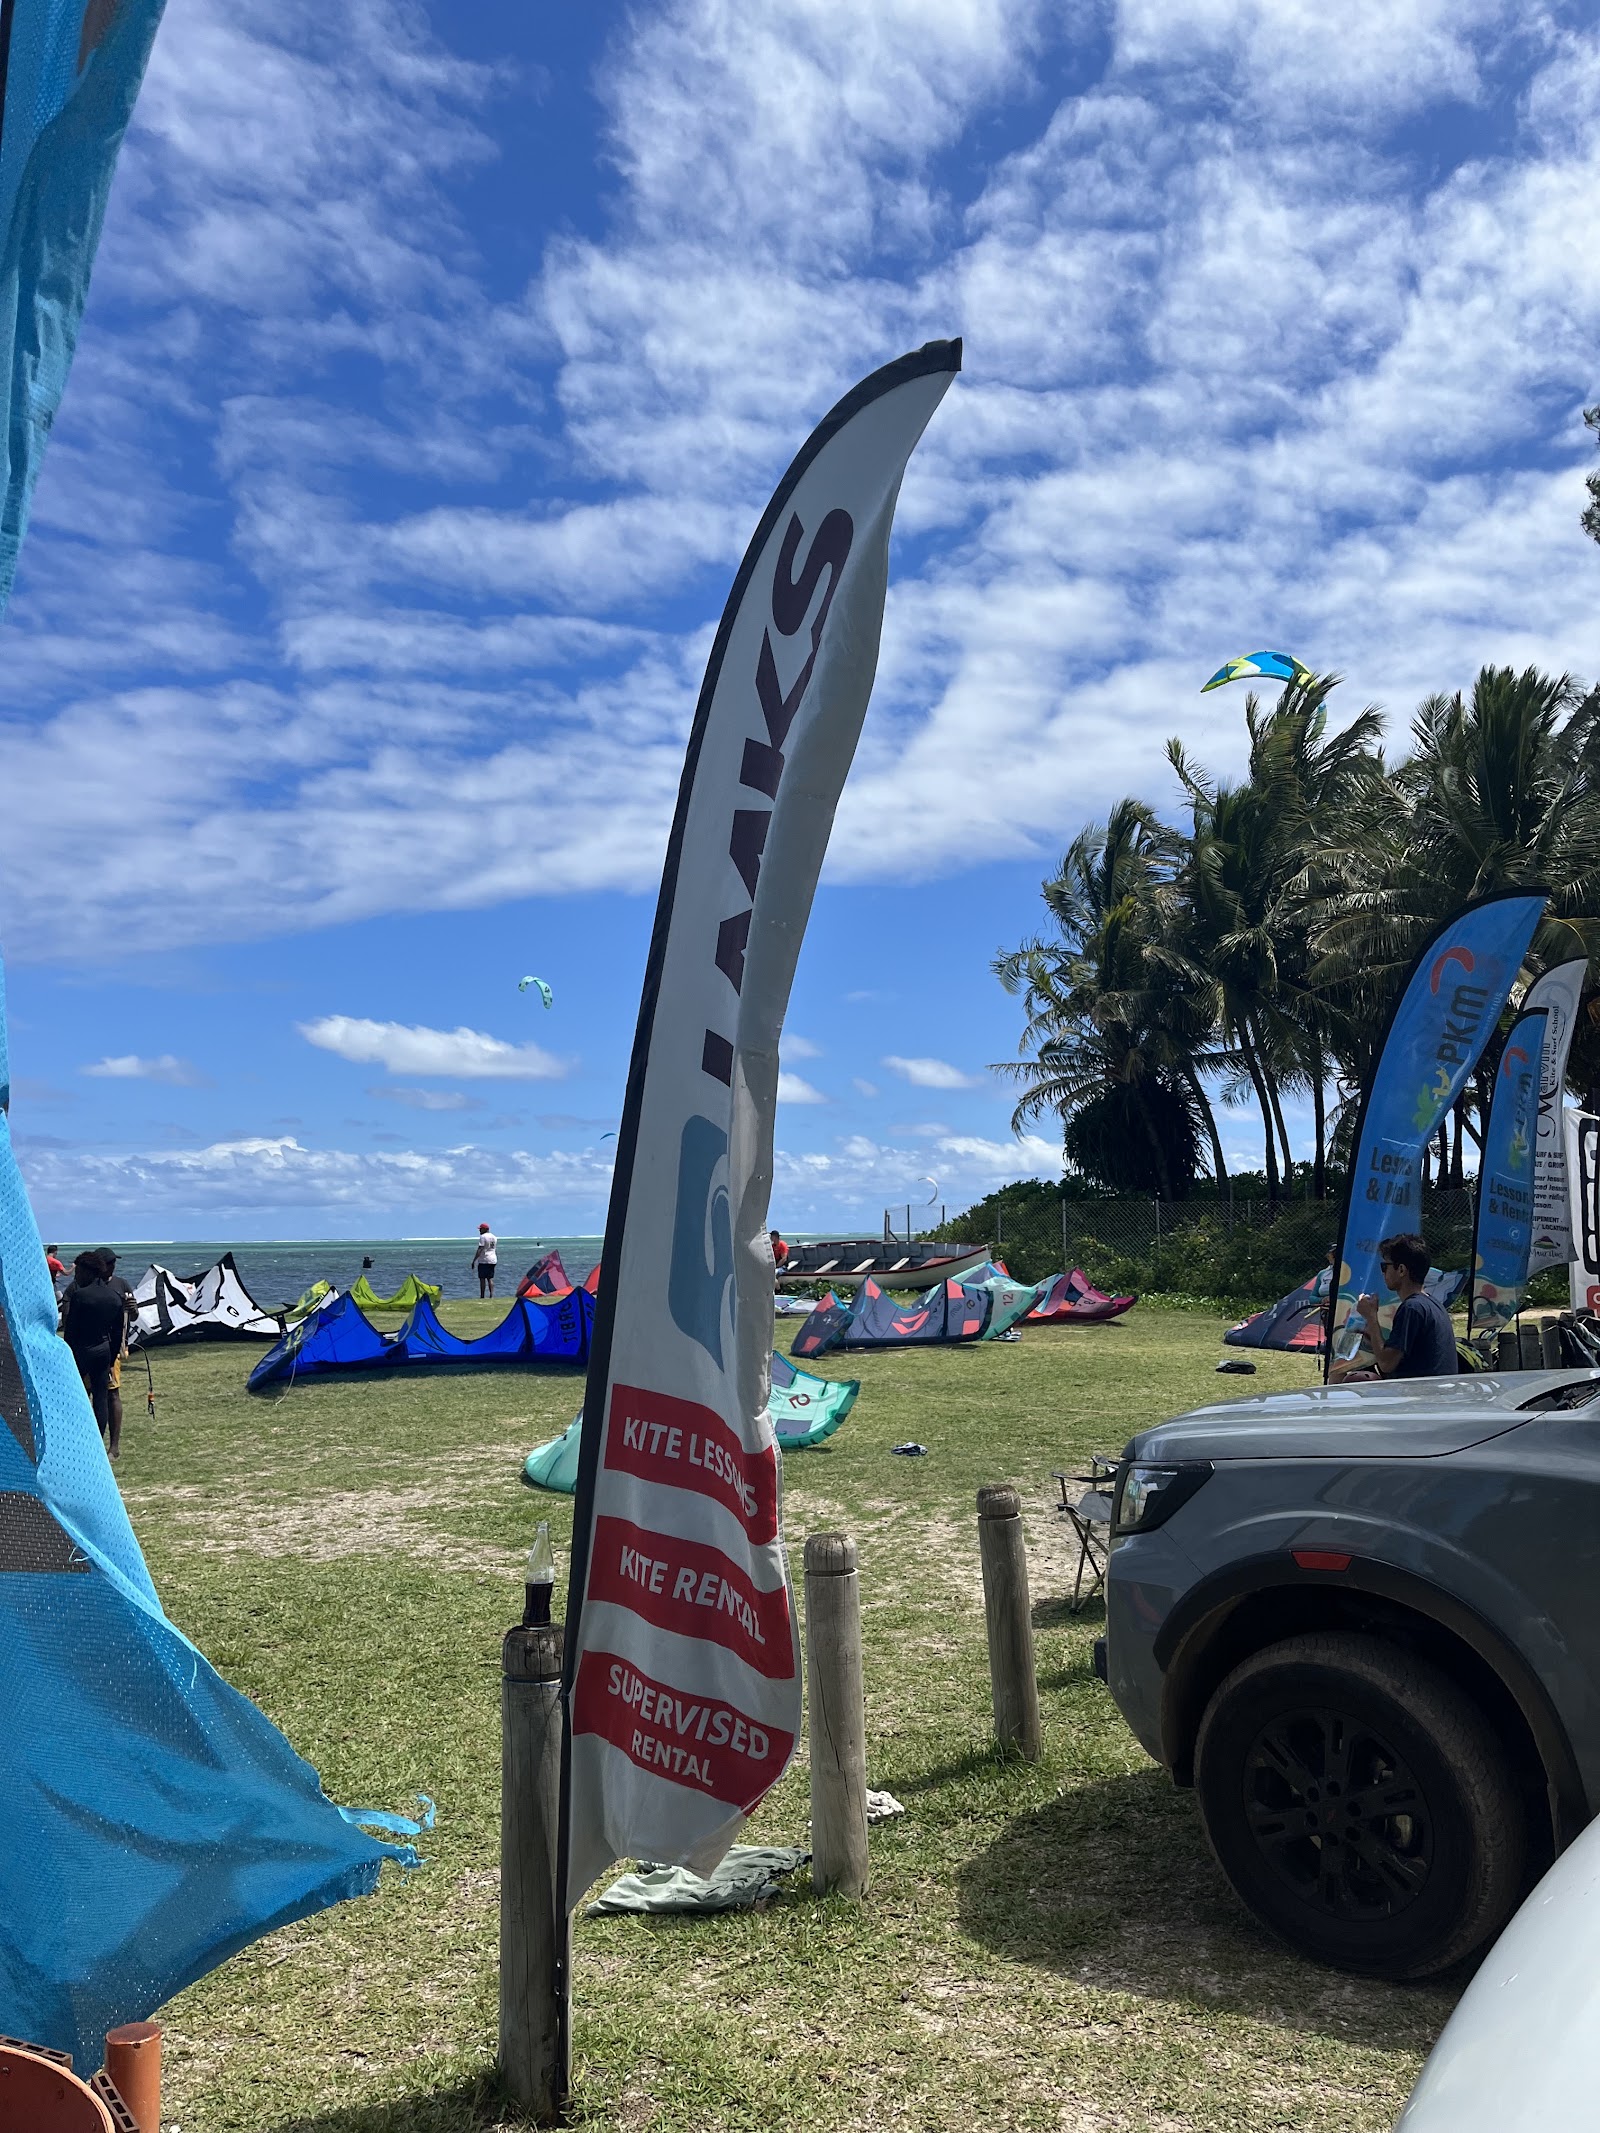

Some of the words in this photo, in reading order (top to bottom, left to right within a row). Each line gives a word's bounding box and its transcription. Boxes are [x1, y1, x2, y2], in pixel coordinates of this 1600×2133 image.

[1551, 1005, 1559, 1035] School
[623, 1416, 682, 1459] KITE
[619, 1545, 668, 1595] KITE
[671, 1567, 767, 1645] RENTAL
[608, 1664, 770, 1760] SUPERVISED
[631, 1728, 714, 1787] RENTAL
